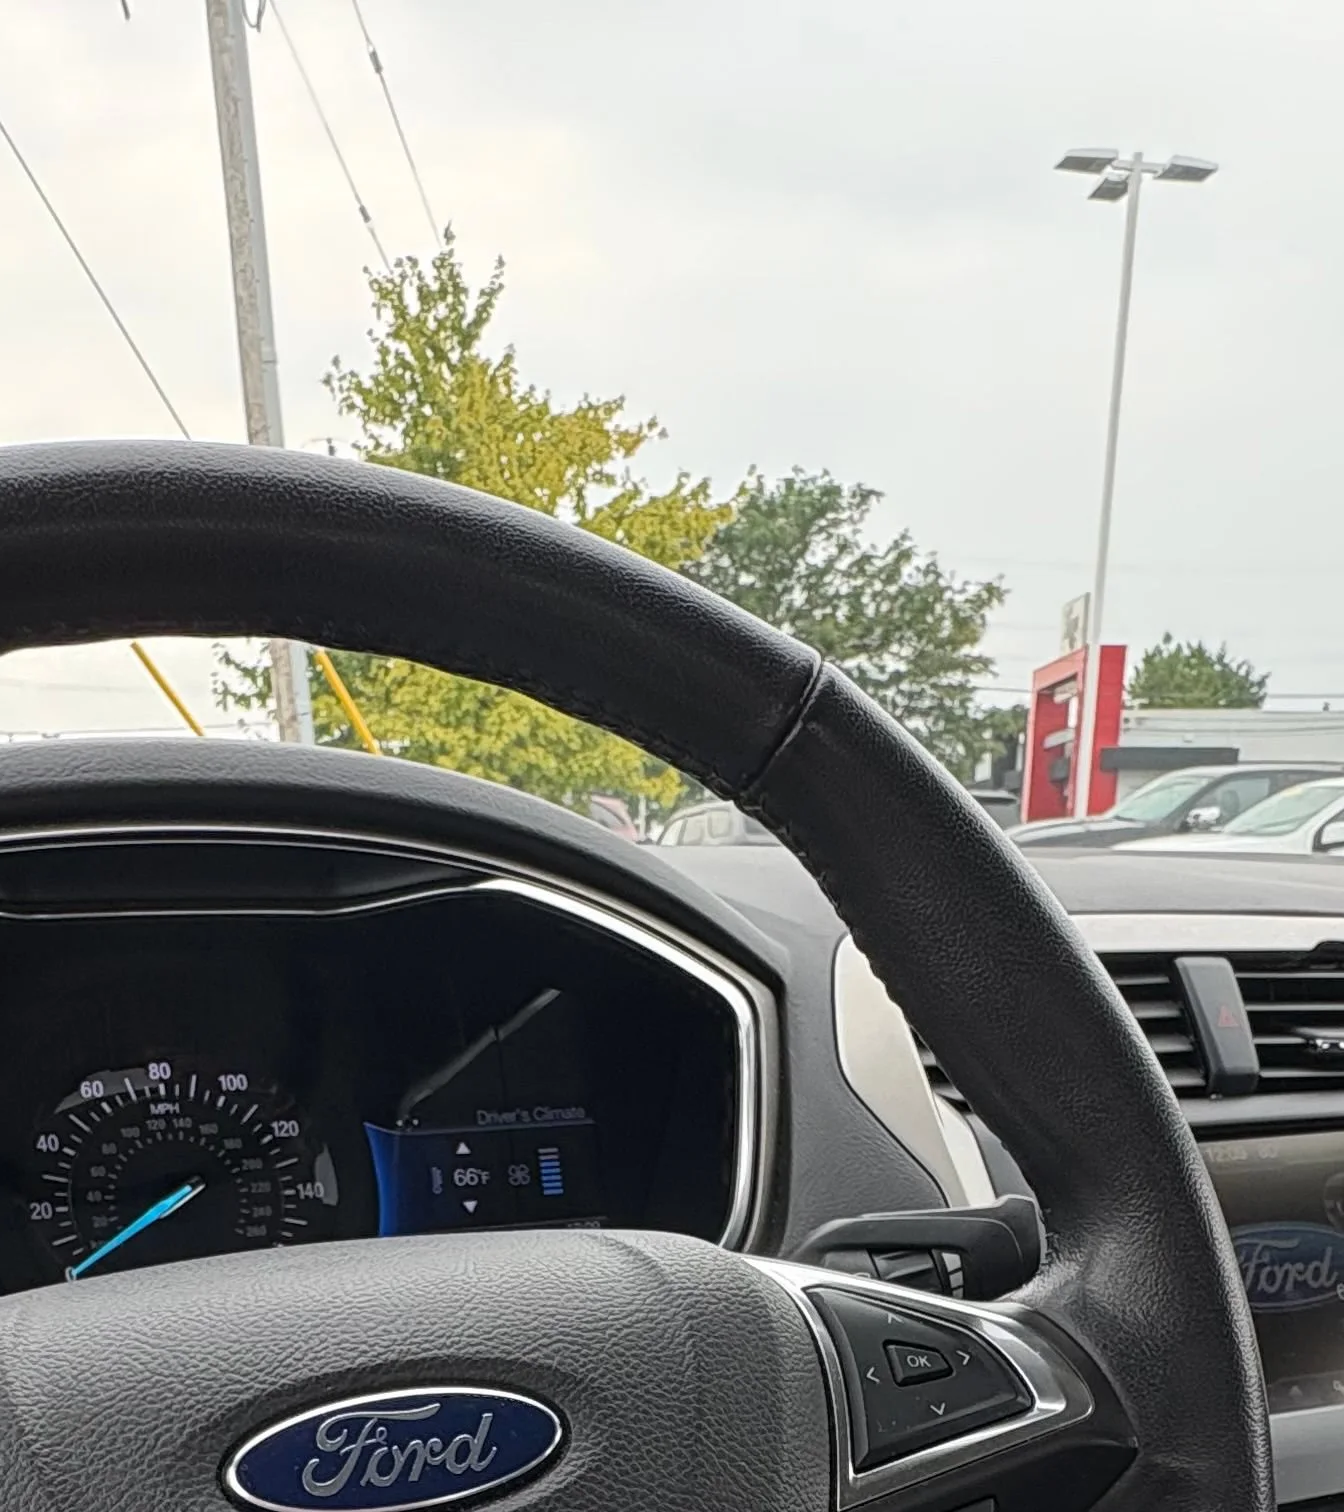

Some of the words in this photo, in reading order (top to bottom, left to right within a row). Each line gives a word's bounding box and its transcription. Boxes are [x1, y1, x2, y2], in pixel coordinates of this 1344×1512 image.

[148, 1062, 171, 1080] 80
[80, 1080, 104, 1098] 60
[218, 1074, 248, 1091] 100
[150, 1102, 180, 1116] MPH
[476, 1108, 530, 1126] Driver's
[533, 1105, 585, 1122] Climate
[272, 1120, 299, 1138] 120
[36, 1134, 59, 1152] 40
[297, 1182, 325, 1200] 140
[30, 1202, 53, 1220] 20
[1236, 1238, 1339, 1293] Ford
[906, 1354, 932, 1368] OK
[301, 1403, 498, 1497] Ford
